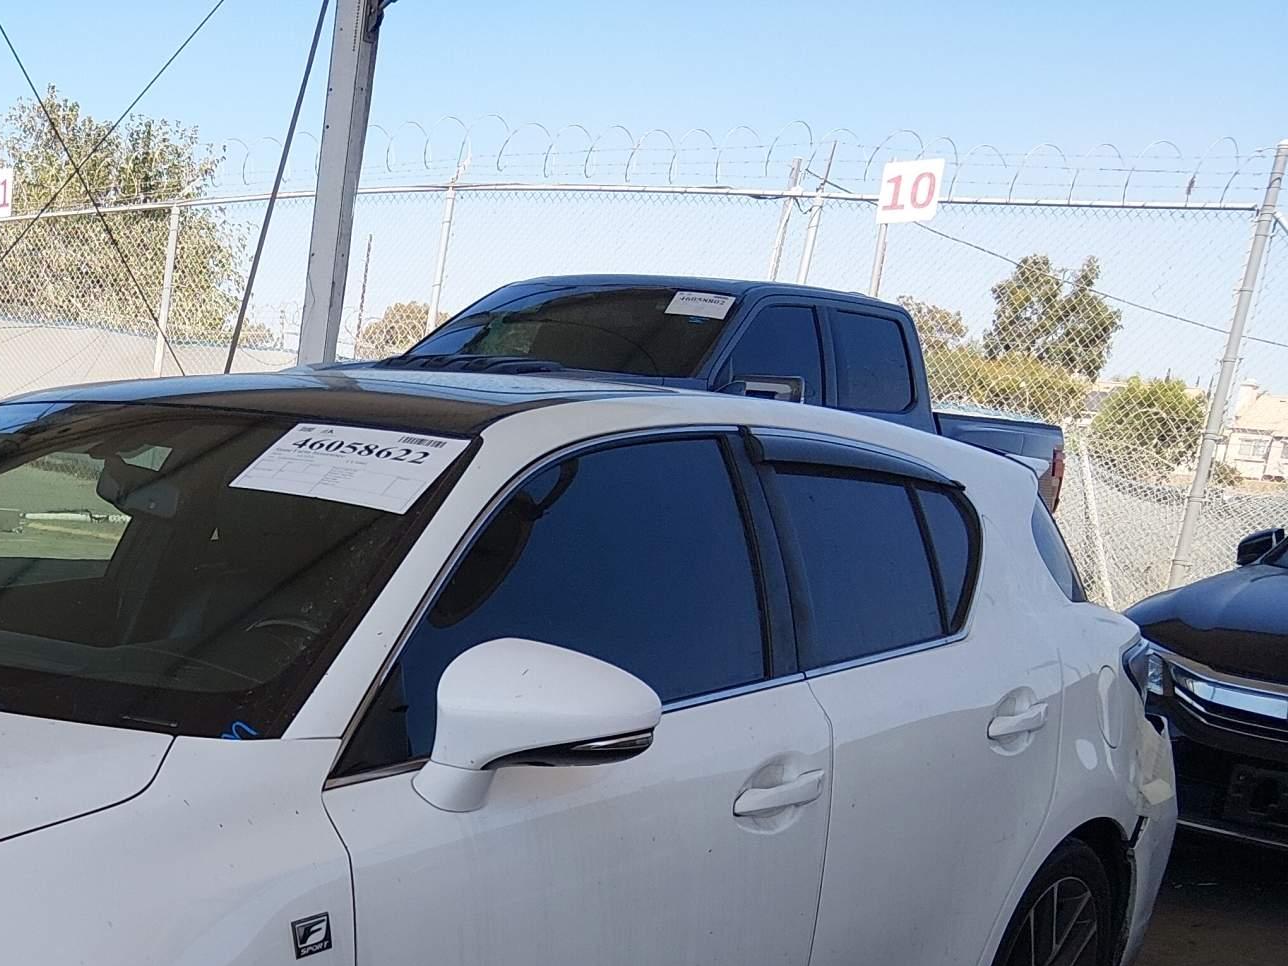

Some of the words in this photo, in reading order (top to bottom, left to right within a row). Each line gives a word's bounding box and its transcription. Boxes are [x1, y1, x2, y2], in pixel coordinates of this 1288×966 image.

[881, 171, 936, 211] 10
[292, 436, 431, 465] 46058622
[300, 940, 329, 956] SPORT
